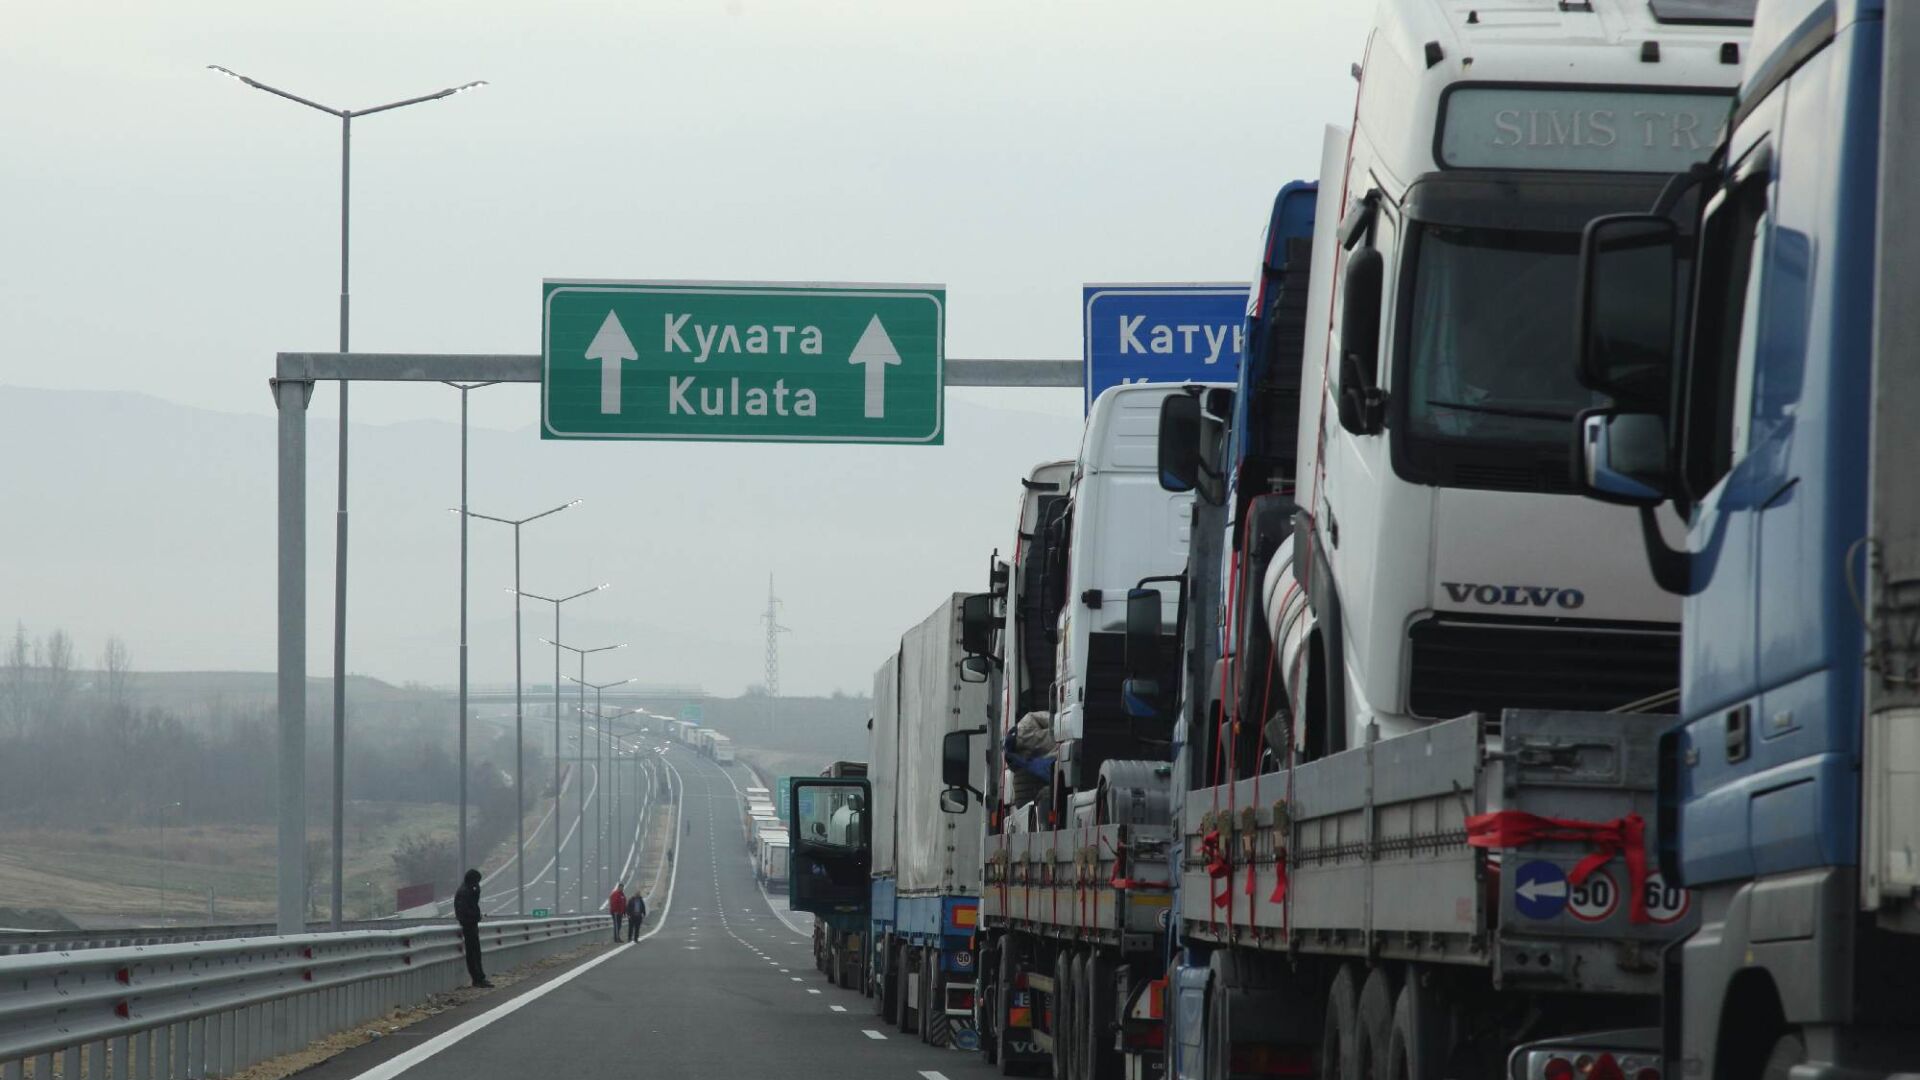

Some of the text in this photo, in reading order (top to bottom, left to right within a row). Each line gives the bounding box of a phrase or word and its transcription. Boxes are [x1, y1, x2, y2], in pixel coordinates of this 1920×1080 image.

[1493, 109, 1617, 147] SIMS
[664, 313, 823, 363] Кулата
[669, 376, 817, 416] Kulata
[1441, 582, 1584, 609] VOLVO
[1572, 881, 1609, 907] 50
[1645, 882, 1679, 910] 60
